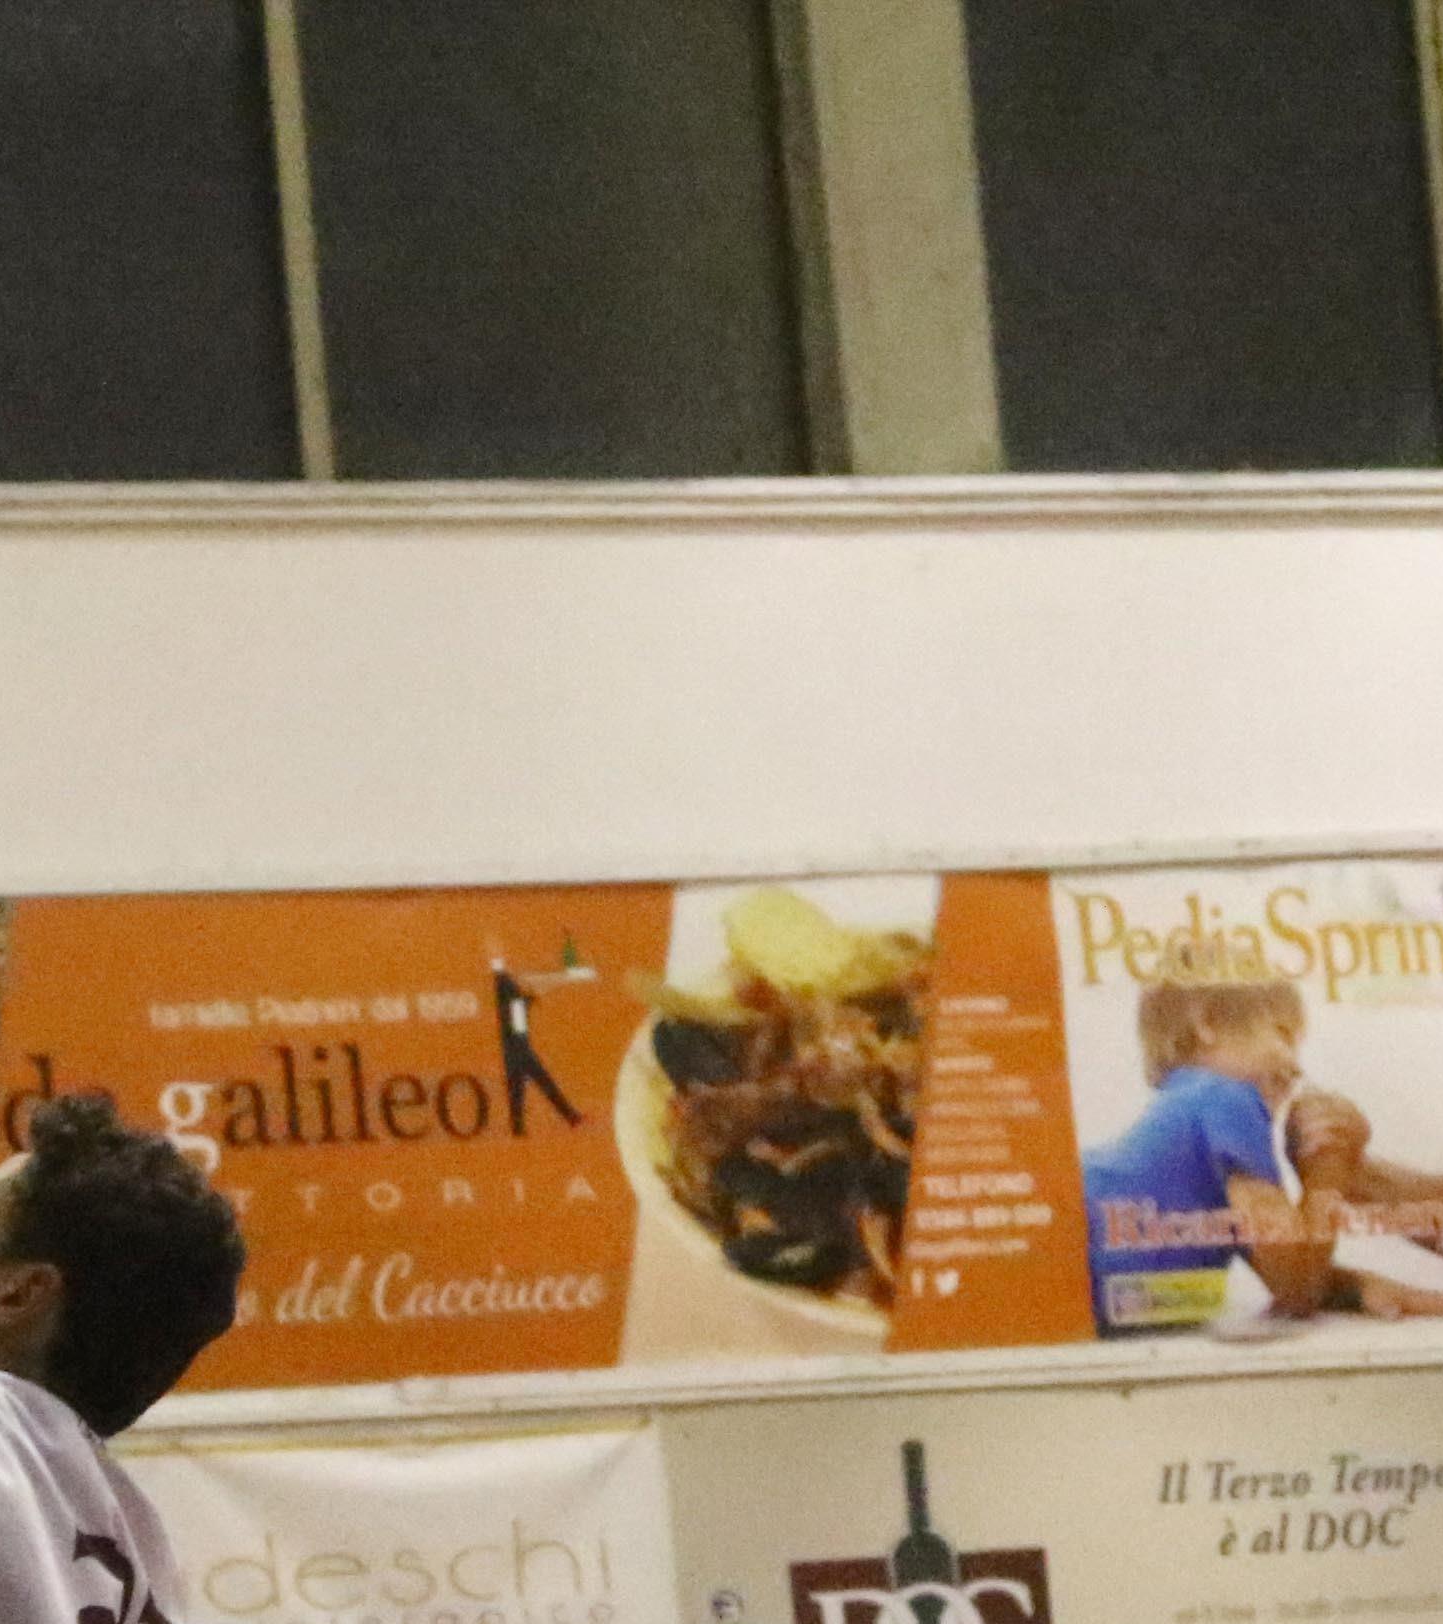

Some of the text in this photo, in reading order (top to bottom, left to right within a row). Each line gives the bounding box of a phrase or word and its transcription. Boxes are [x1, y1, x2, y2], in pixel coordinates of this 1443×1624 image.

[158, 1040, 490, 1174] galileo
[275, 1253, 364, 1324] del
[1205, 1460, 1312, 1502] Terzo
[1250, 1513, 1289, 1556] al
[1302, 1506, 1413, 1553] DOC
